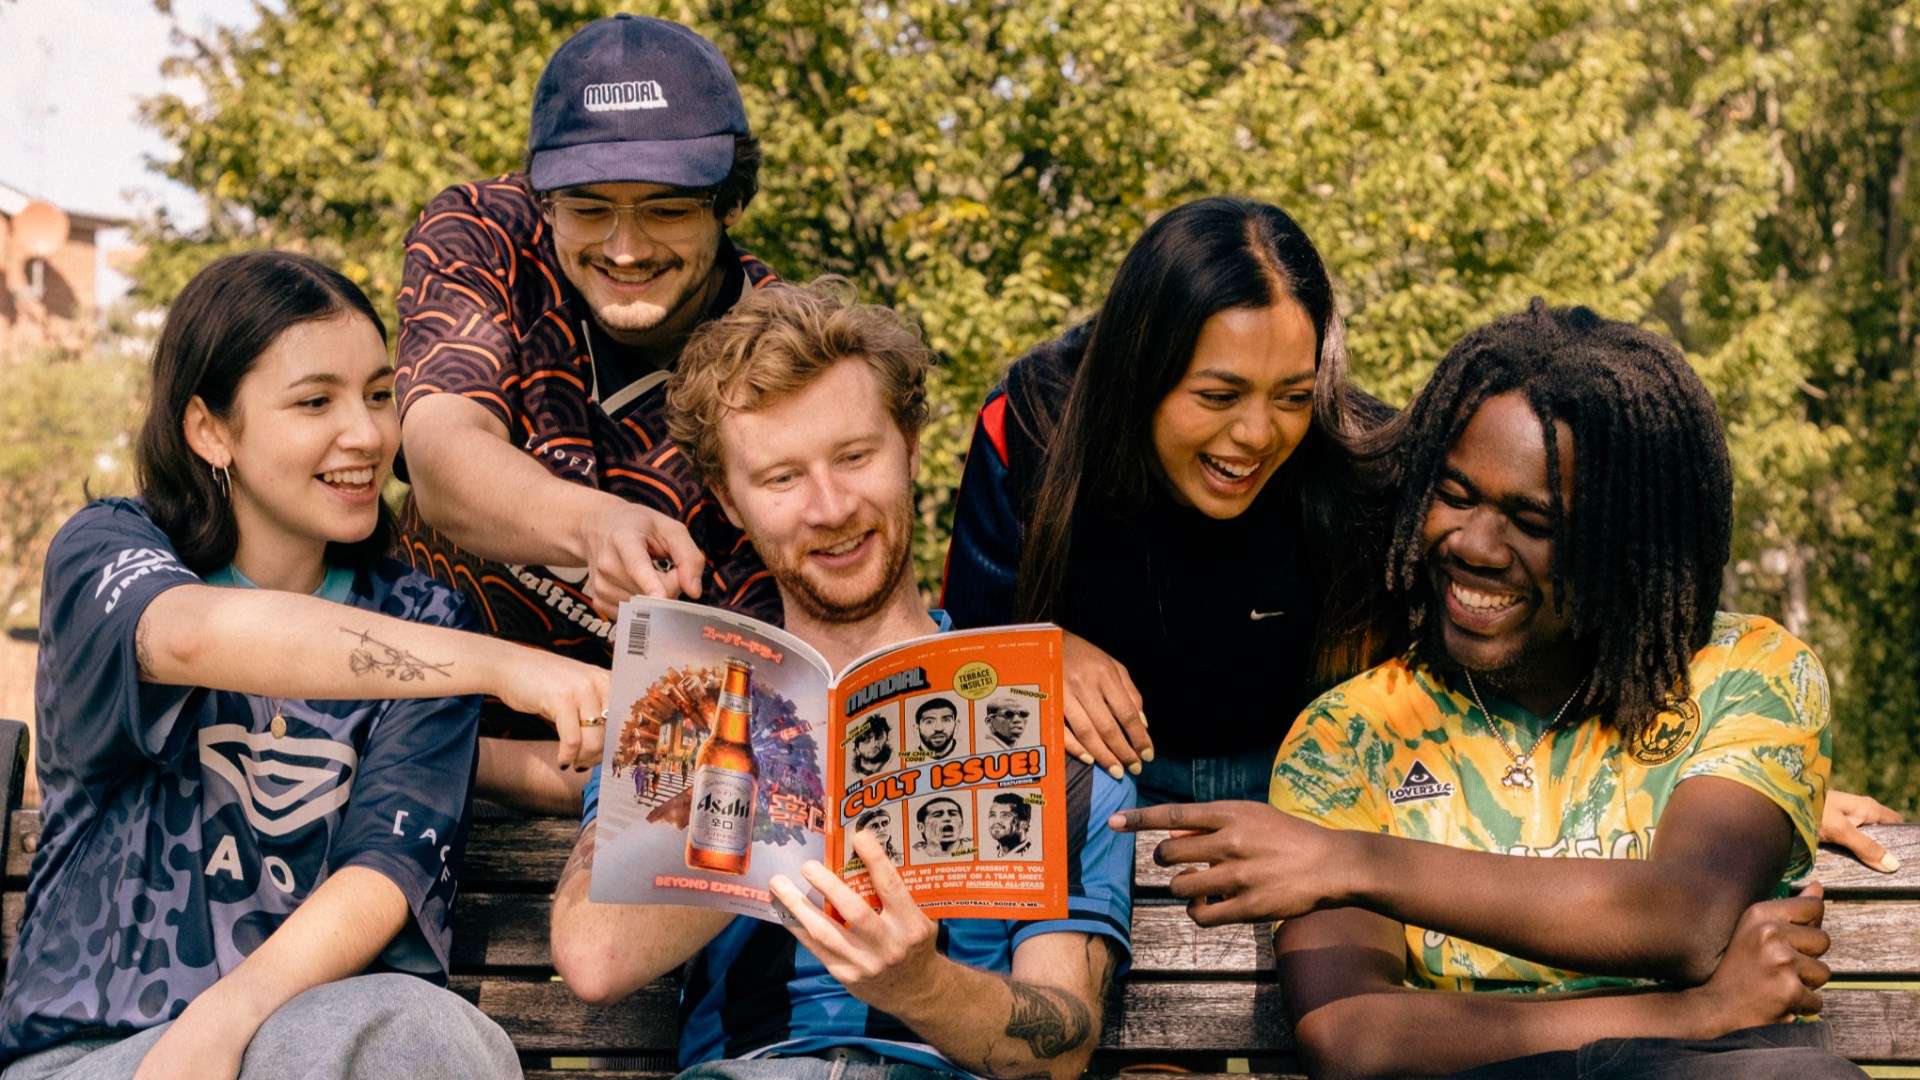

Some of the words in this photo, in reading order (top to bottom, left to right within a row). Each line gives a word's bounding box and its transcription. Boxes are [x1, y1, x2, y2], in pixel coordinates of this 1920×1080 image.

[584, 80, 665, 109] MUNDIAL
[959, 668, 990, 683] TERRACE
[960, 677, 993, 690] INSULTS!
[846, 666, 929, 716] MUNDIAL
[843, 770, 921, 818] CULT
[930, 749, 1040, 790] ISSUE!
[1389, 783, 1434, 799] LOVER'S
[1436, 783, 1455, 792] F.C.
[696, 792, 750, 819] Asahi
[655, 875, 708, 890] BEYOND
[966, 880, 1002, 889] MUNDIAL
